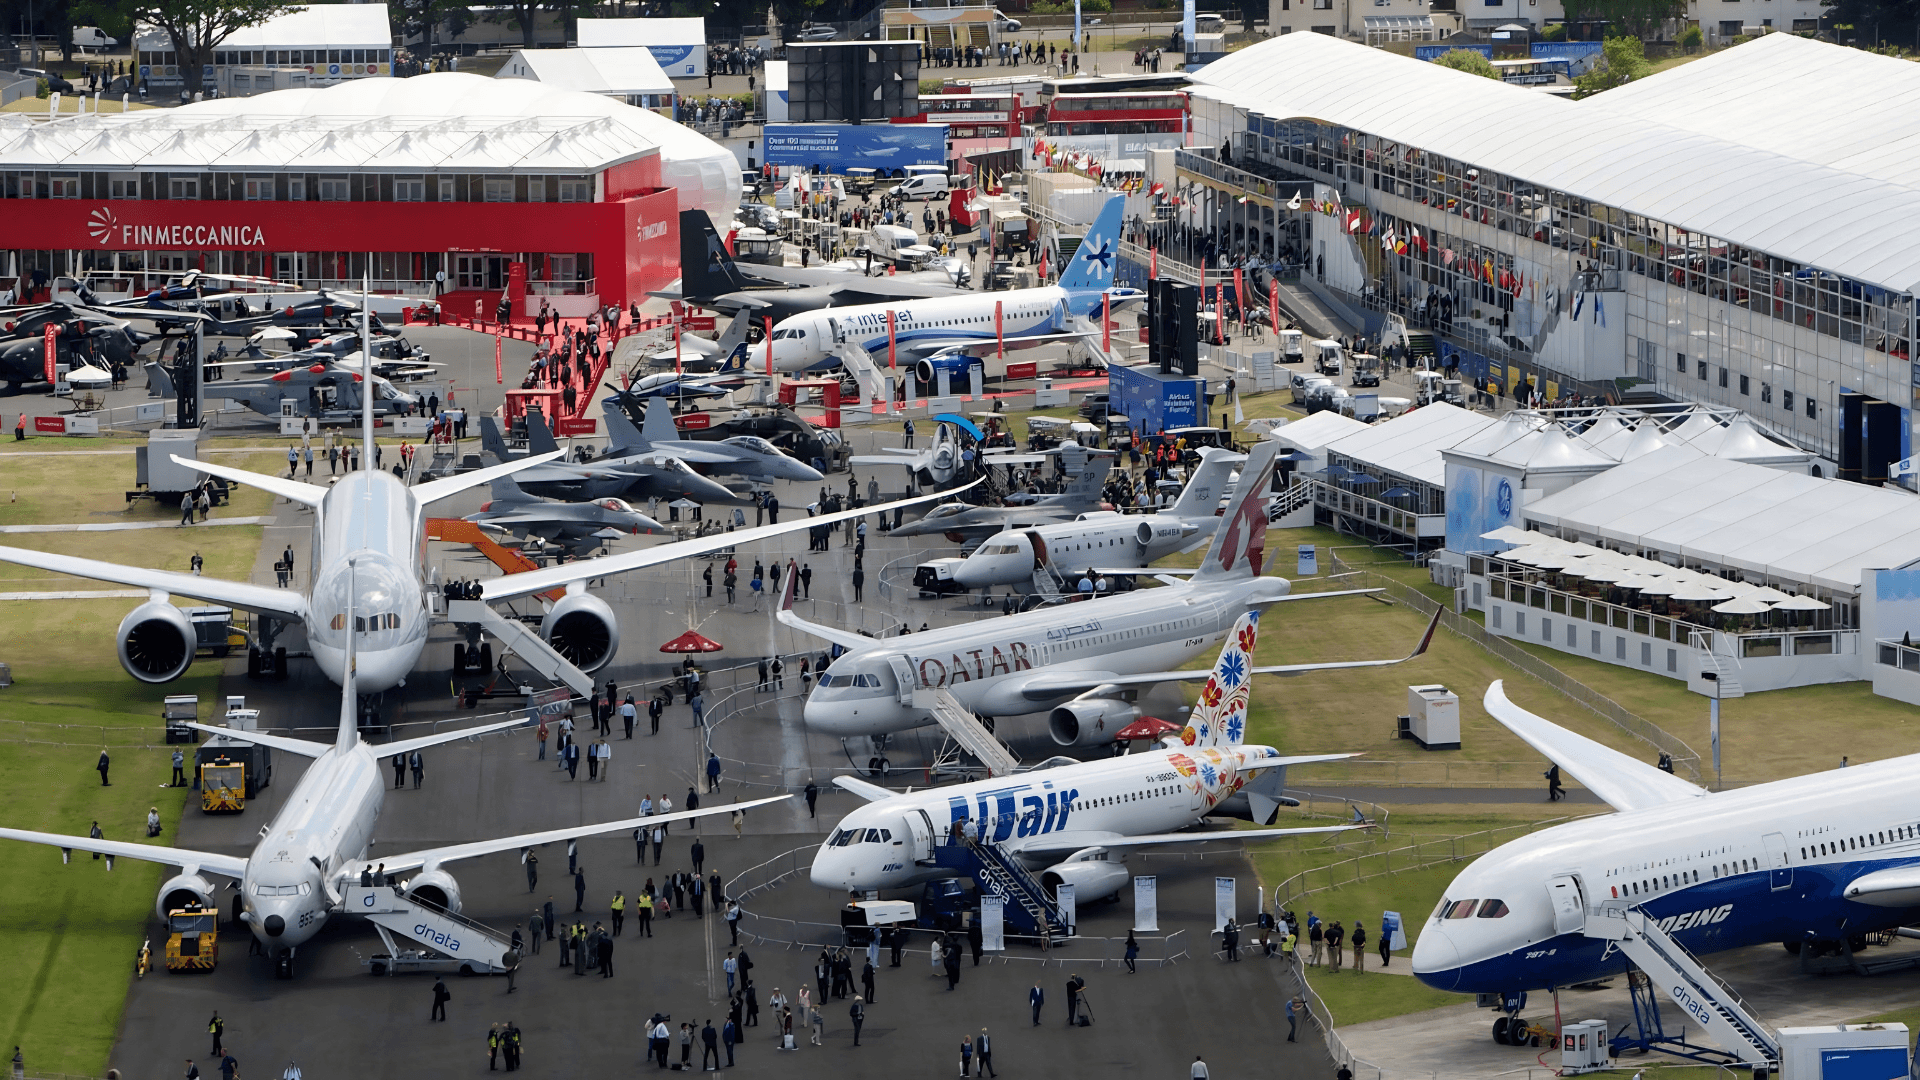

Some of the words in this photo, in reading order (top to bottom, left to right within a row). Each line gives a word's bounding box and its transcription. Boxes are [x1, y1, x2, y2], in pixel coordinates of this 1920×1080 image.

[123, 225, 265, 246] FINMECCANICA
[919, 641, 1032, 688] QATAR
[979, 867, 1010, 905] dnata
[1653, 903, 1734, 934] OEING
[414, 923, 462, 952] dnata
[1672, 985, 1711, 1025] dnata
